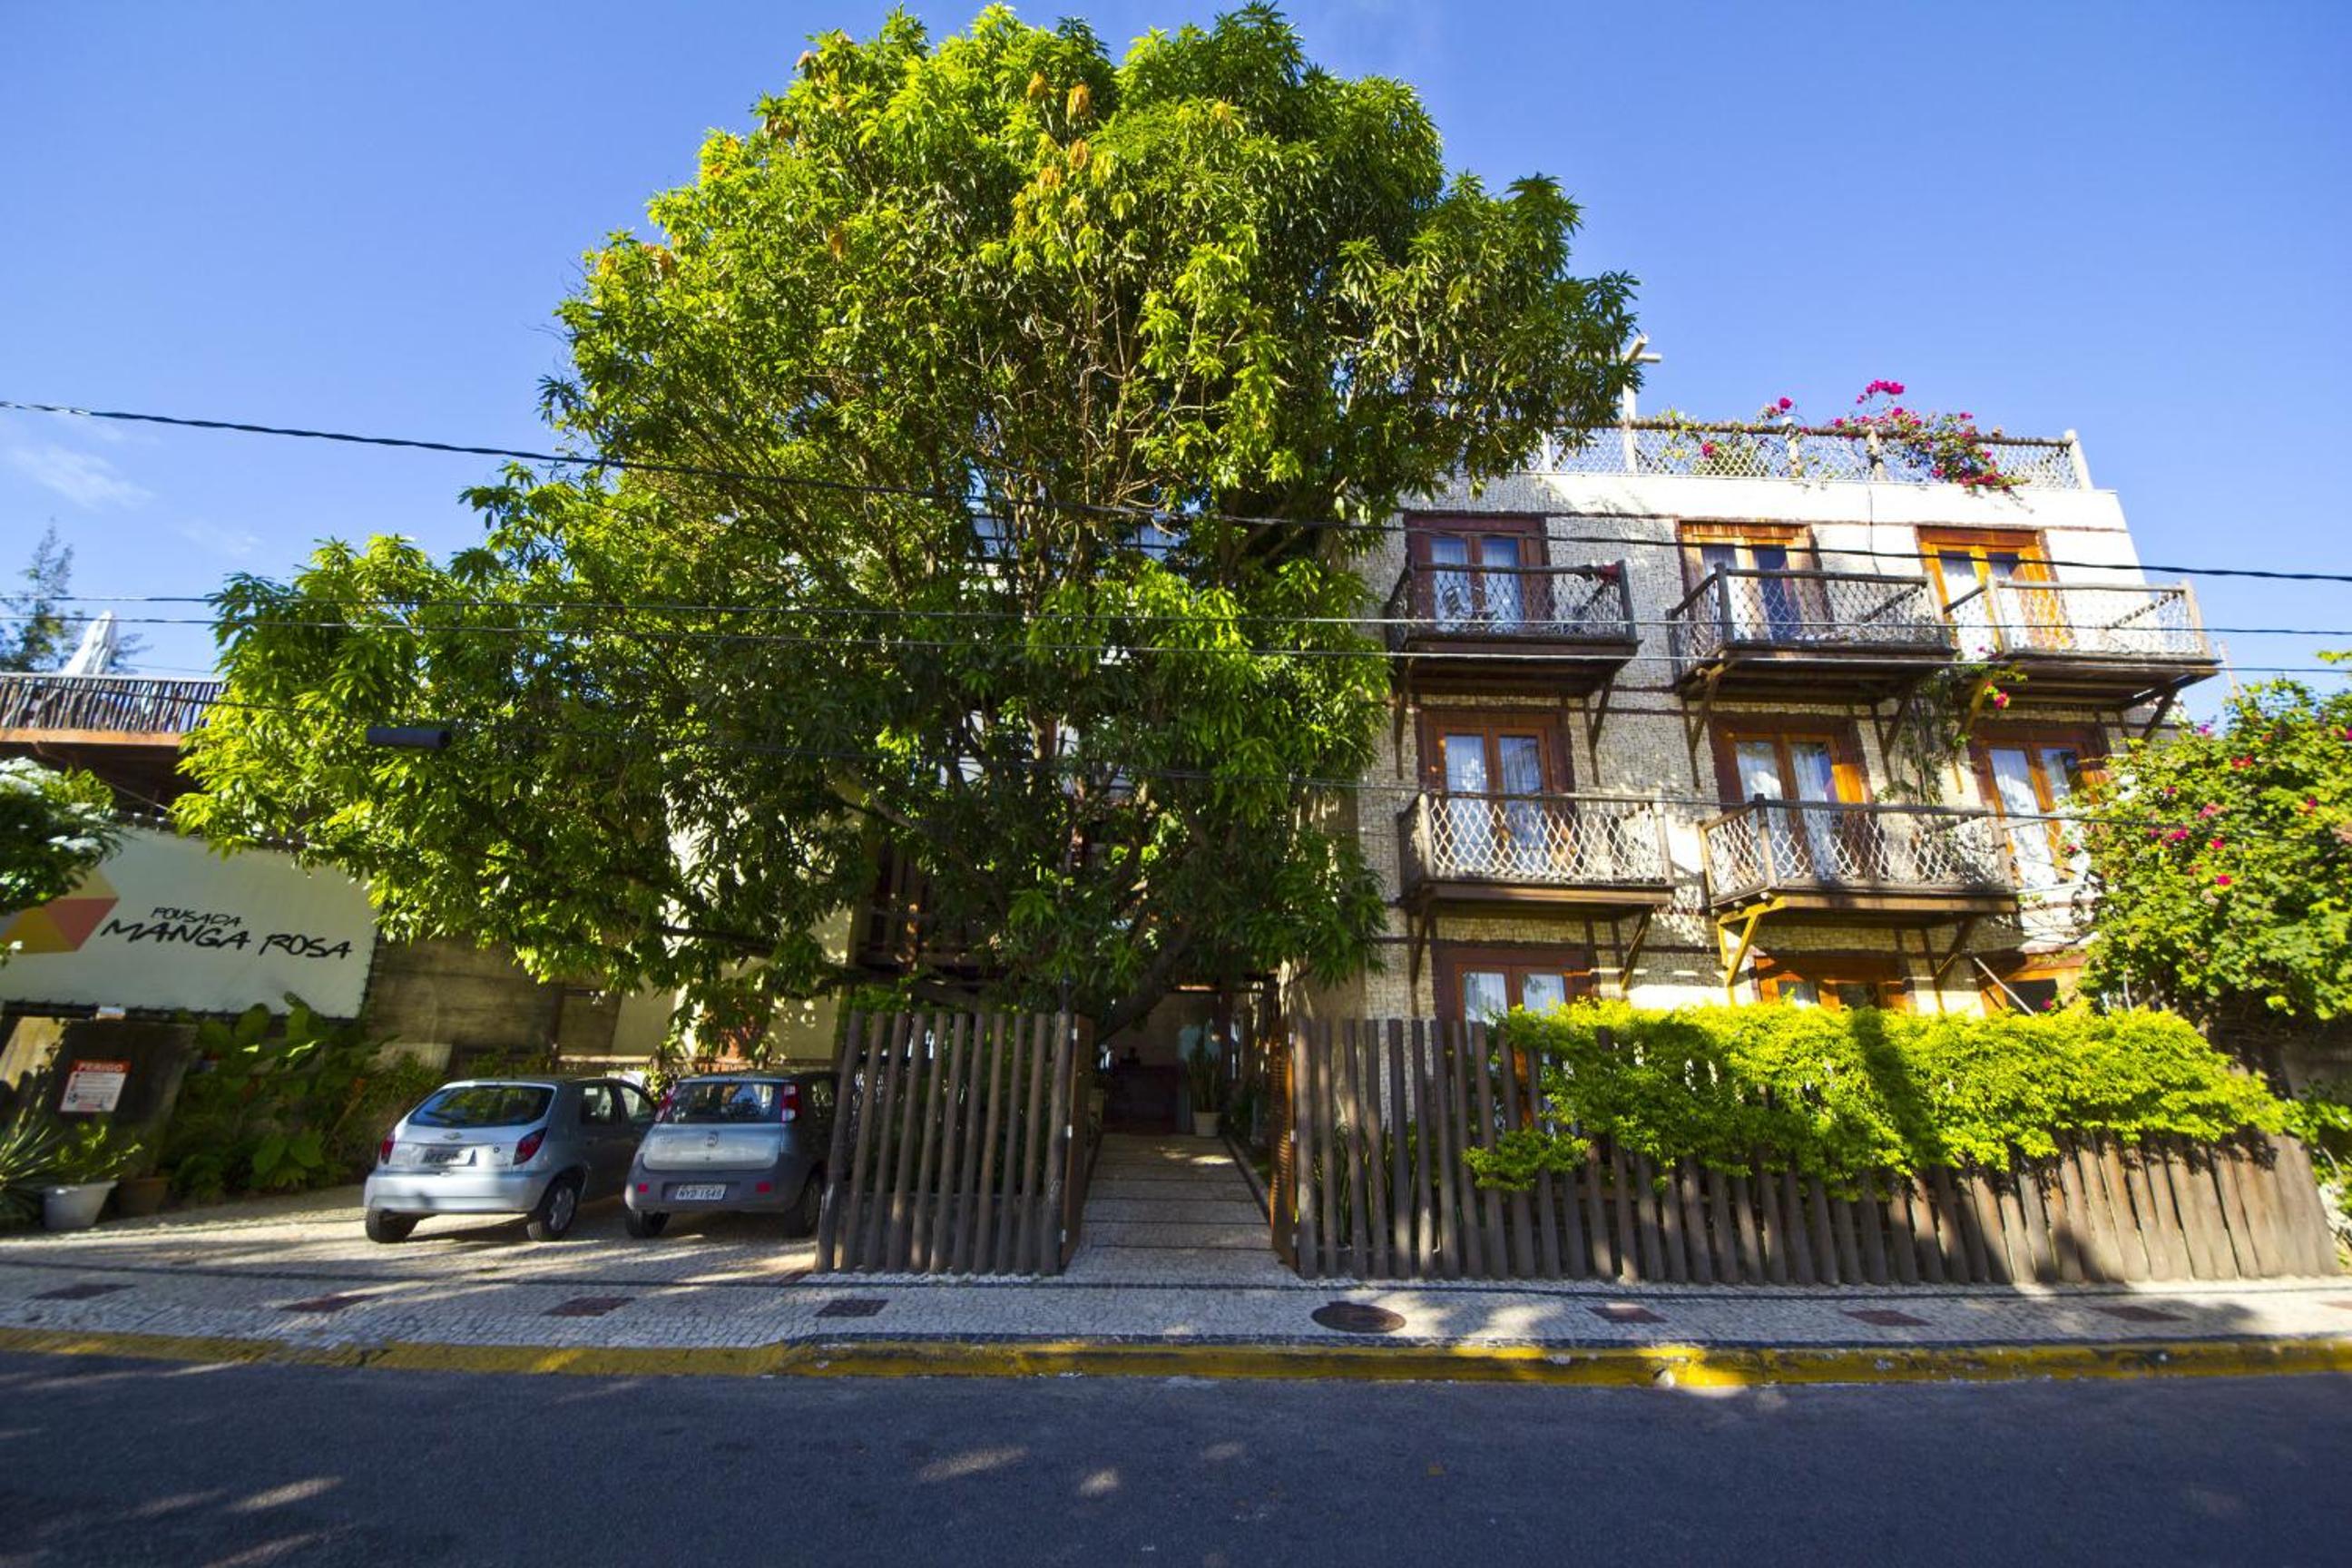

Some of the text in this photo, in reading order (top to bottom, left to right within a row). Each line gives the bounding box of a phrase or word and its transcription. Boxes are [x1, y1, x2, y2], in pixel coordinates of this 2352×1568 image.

[151, 906, 242, 927] POUSADA
[101, 919, 352, 959] MANGA ROSA
[77, 1062, 125, 1073] PERIGO
